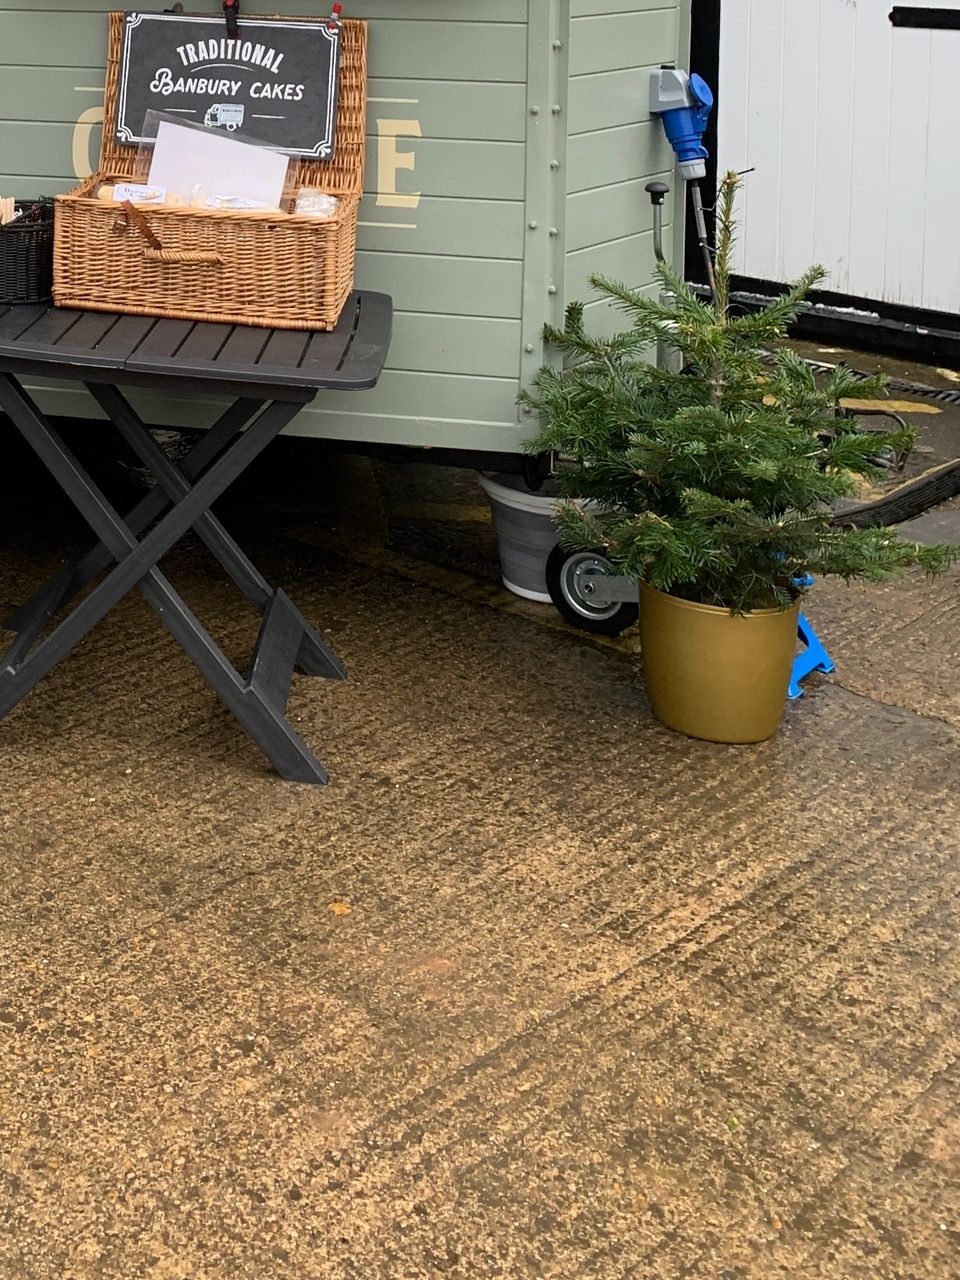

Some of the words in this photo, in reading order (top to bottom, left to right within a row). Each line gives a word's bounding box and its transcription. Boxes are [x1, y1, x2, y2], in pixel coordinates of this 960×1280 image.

[176, 38, 285, 73] TRADITIONAL
[149, 68, 242, 96] BANBURY
[249, 81, 305, 100] CAKES
